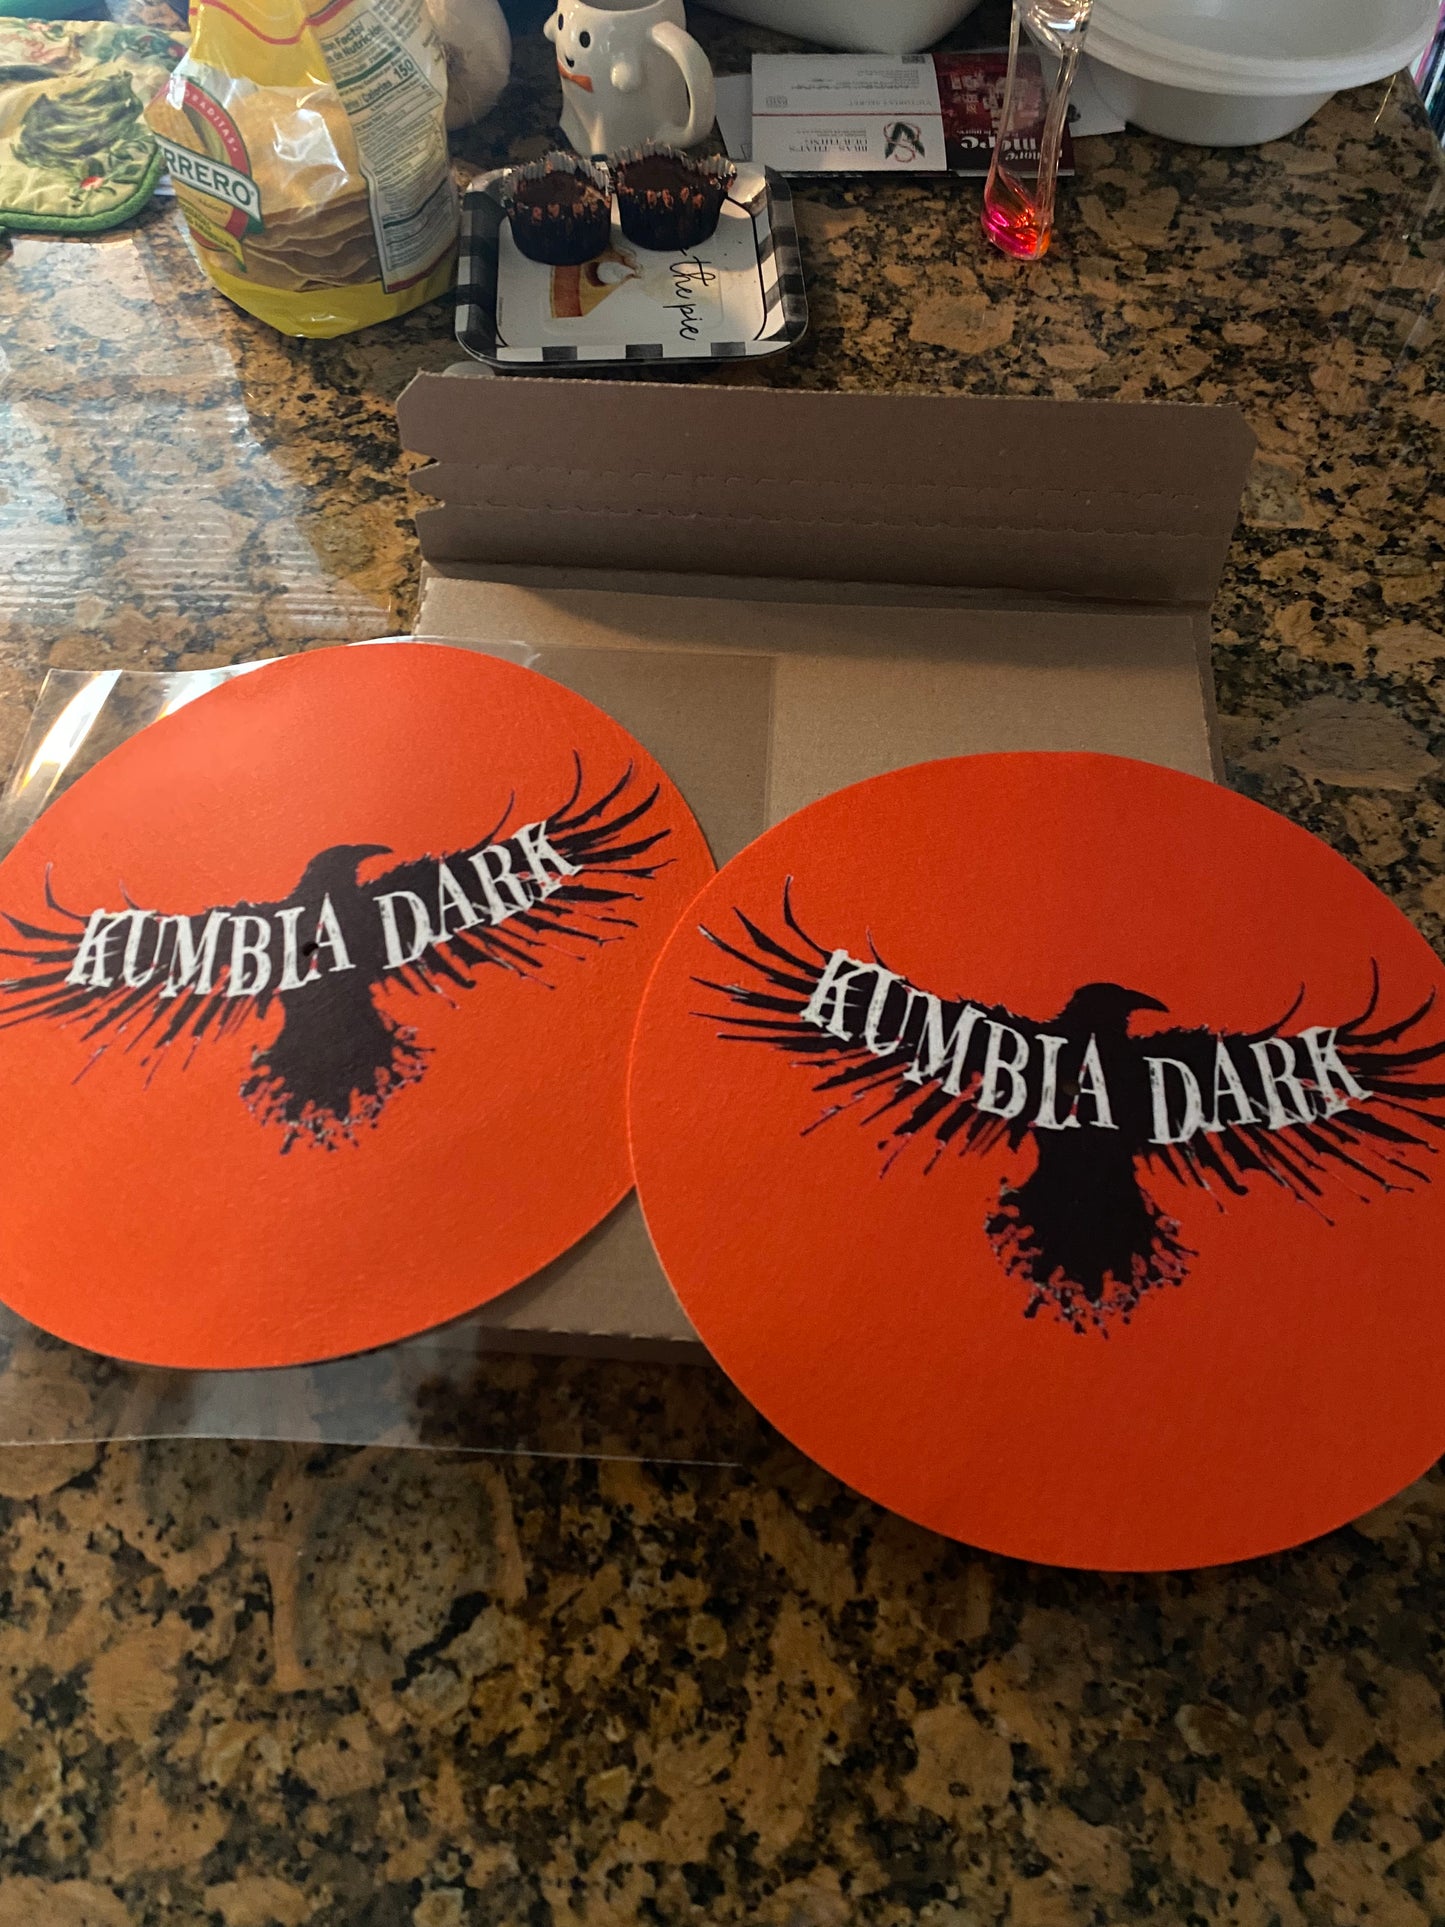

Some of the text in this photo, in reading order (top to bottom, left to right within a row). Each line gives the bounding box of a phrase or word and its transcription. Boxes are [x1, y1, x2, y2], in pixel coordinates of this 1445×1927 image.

[393, 58, 415, 80] 150
[663, 256, 716, 341] the pie
[65, 820, 583, 999] KUMBIA DARK
[799, 948, 1375, 1146] KUMBIA DARK
